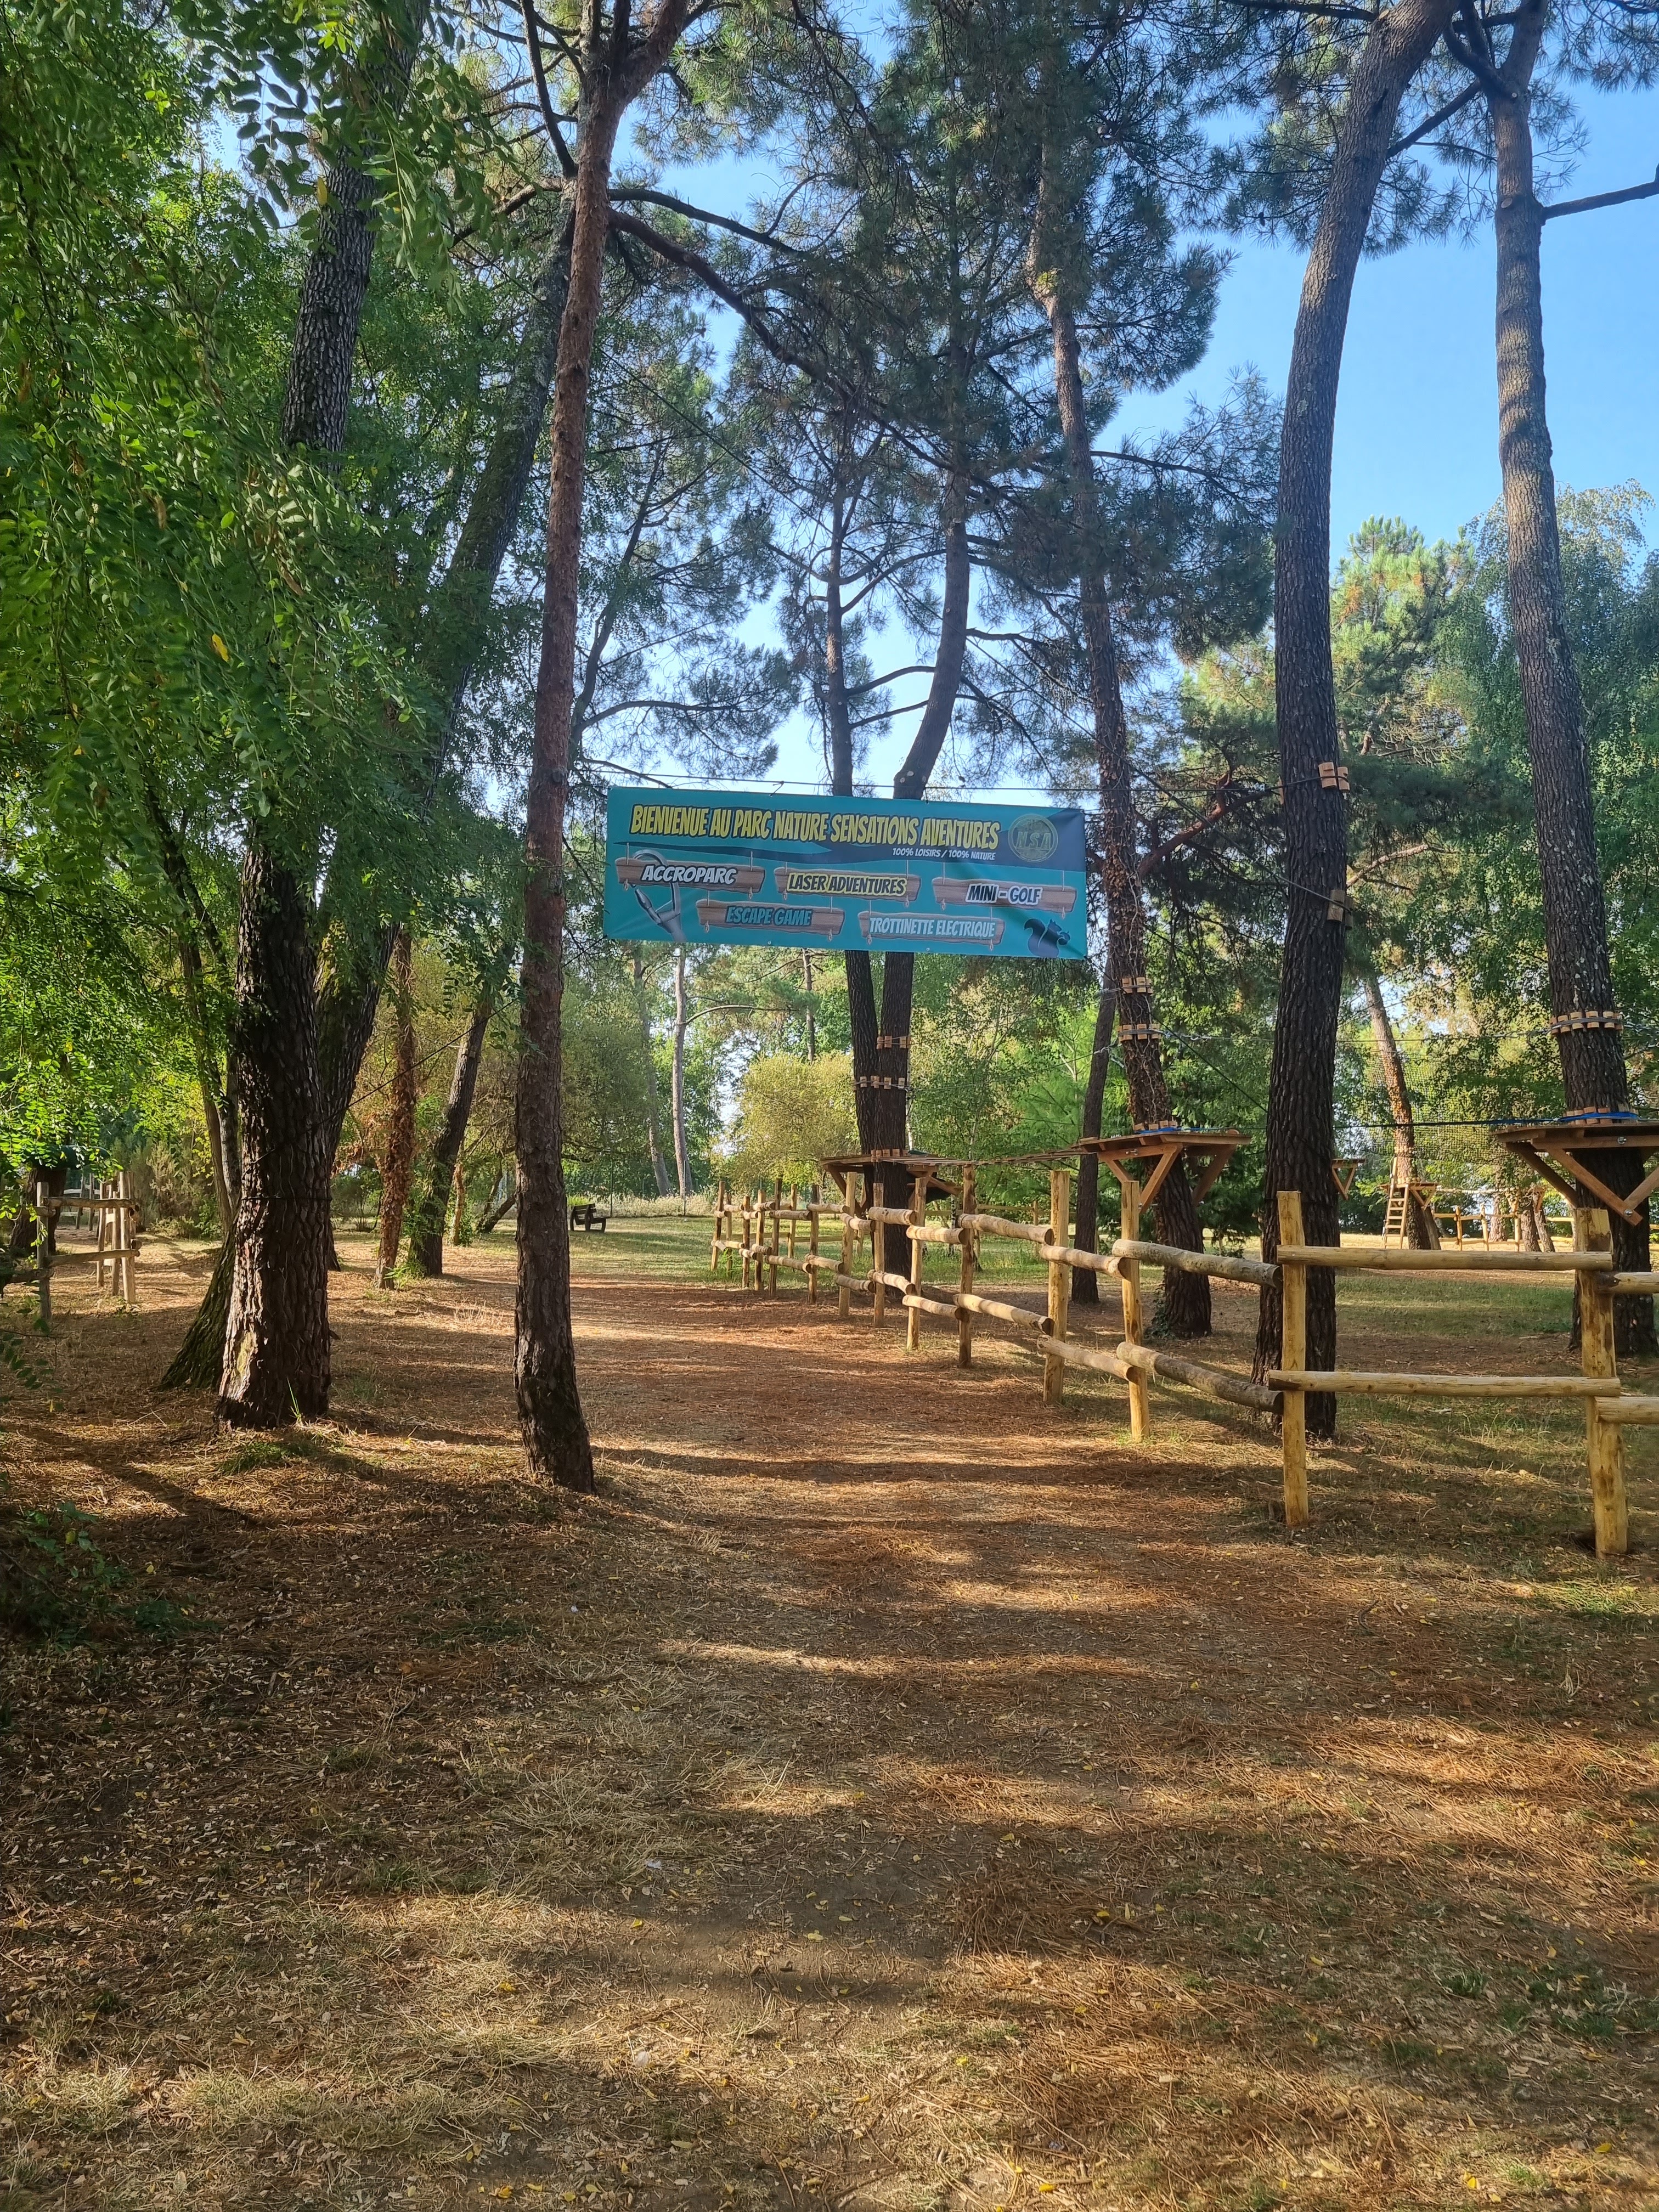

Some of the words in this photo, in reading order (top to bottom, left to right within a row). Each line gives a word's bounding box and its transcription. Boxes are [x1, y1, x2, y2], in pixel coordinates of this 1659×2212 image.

[630, 805, 709, 837] BIENVENUE
[709, 809, 732, 837] AU
[732, 809, 772, 839] PARC
[773, 811, 829, 841] NATURE
[830, 814, 919, 845] SENSATIONS
[920, 818, 1001, 850] AVENTURES
[892, 848, 913, 856] 100%
[915, 849, 941, 857] LOISIRS
[949, 850, 969, 858] 100%
[970, 851, 996, 860] NATURE
[641, 865, 737, 884] ACCROPARC
[789, 874, 827, 890] LASER
[828, 876, 905, 894] ADVENTURES
[726, 906, 771, 924] ESCAPE
[774, 909, 812, 926] GAME
[870, 917, 935, 935] TROTTINETTE
[935, 920, 996, 938] ELECTRIQUE
